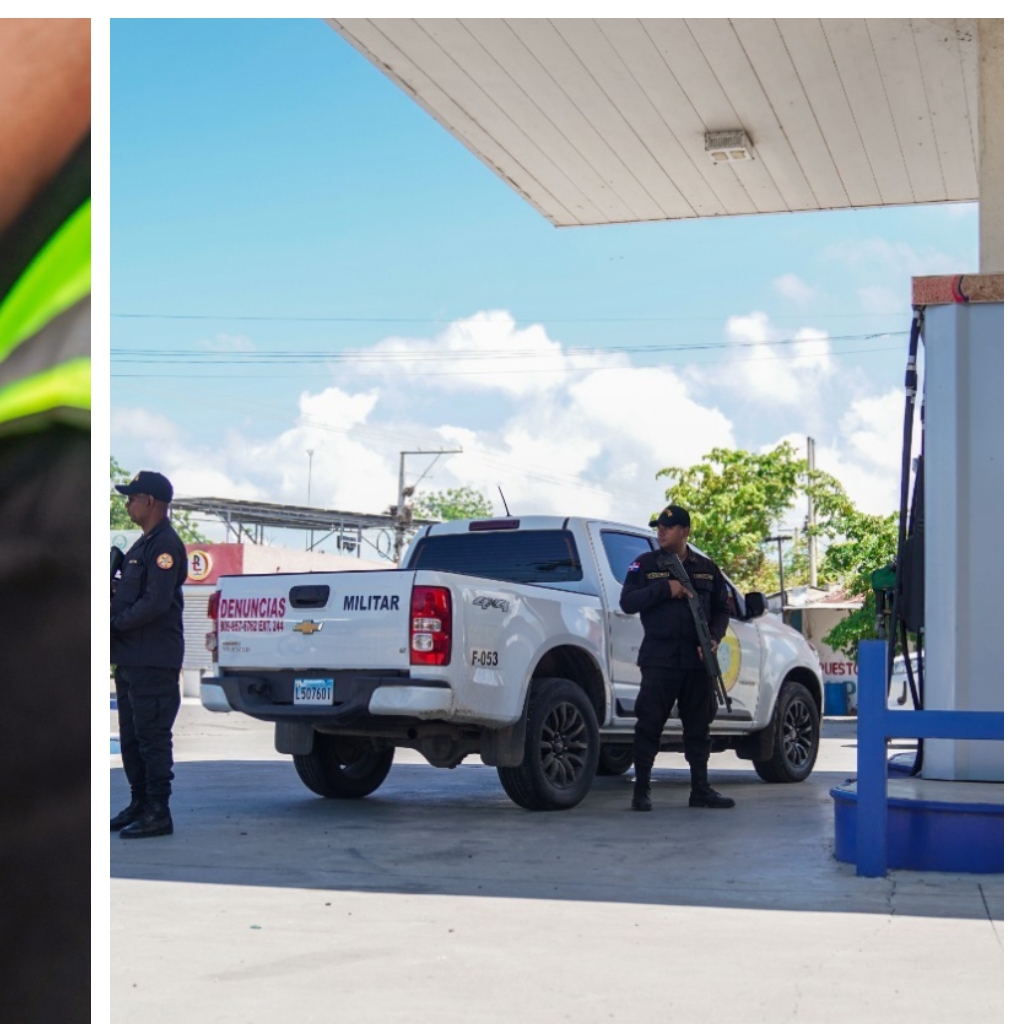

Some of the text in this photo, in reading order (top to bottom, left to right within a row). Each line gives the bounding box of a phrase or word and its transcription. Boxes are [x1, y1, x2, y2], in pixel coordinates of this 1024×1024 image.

[220, 597, 286, 618] DENUNCIAS
[343, 595, 400, 611] MILITAR
[471, 650, 499, 666] F-053
[295, 687, 331, 700] L507601
